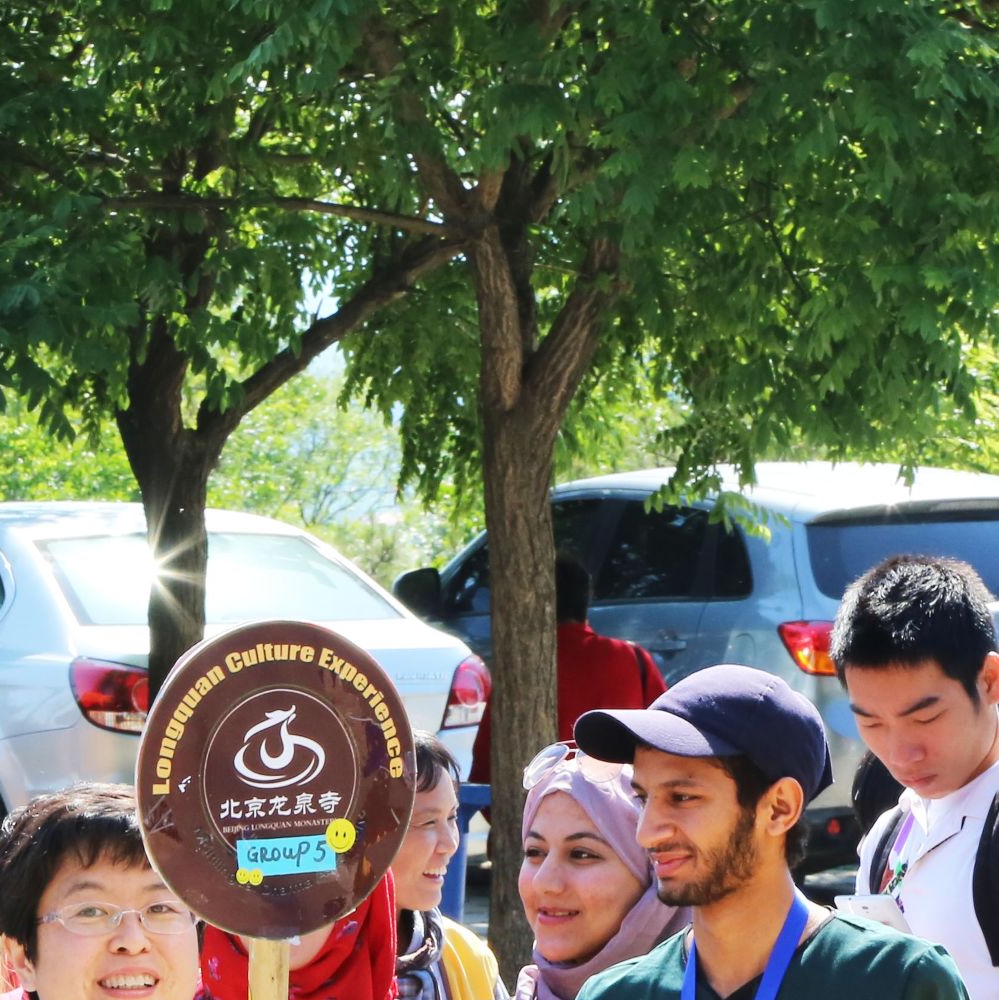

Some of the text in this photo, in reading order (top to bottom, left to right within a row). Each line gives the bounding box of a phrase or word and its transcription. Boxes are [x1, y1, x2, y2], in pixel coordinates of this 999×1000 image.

[151, 642, 403, 796] Longquan Culture Experience
[219, 790, 342, 819] 北京龙泉寺
[222, 818, 337, 834] BEIJING LONGQUAN MONASTE
[313, 841, 327, 863] 5
